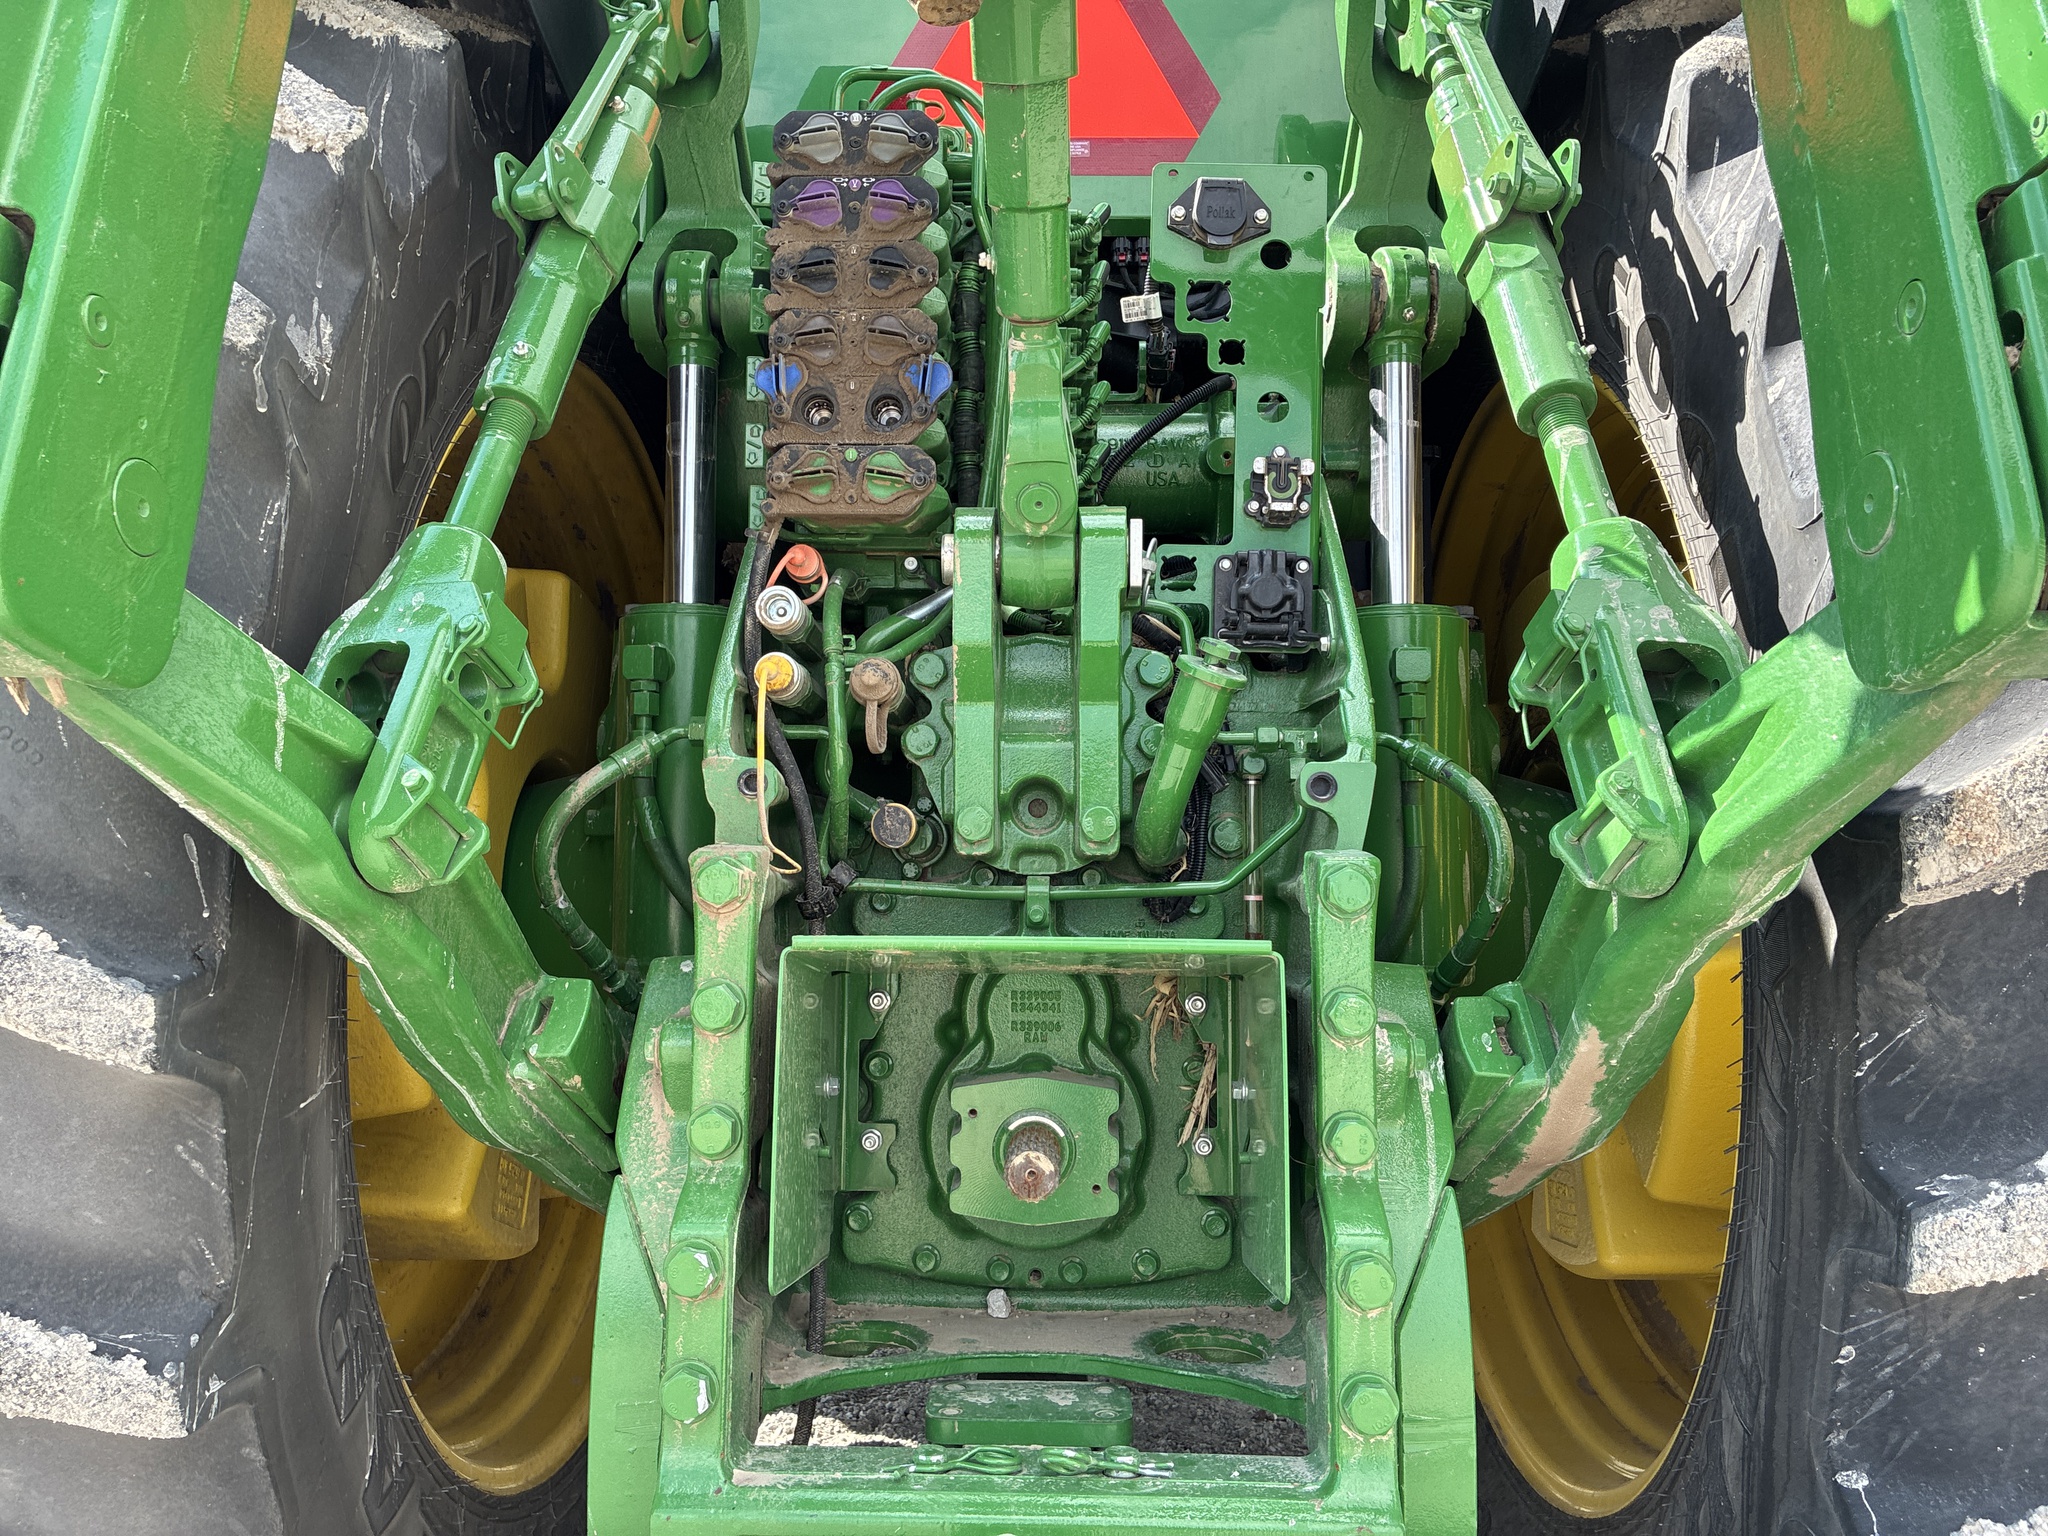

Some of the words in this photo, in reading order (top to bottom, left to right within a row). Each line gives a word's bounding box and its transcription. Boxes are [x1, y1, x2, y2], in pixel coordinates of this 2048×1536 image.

[1206, 205, 1236, 219] Pollak
[1146, 470, 1181, 487] USA
[1010, 1002, 1062, 1014] R344341
[1010, 1020, 1062, 1032] R339006
[1023, 1032, 1048, 1043] RAW
